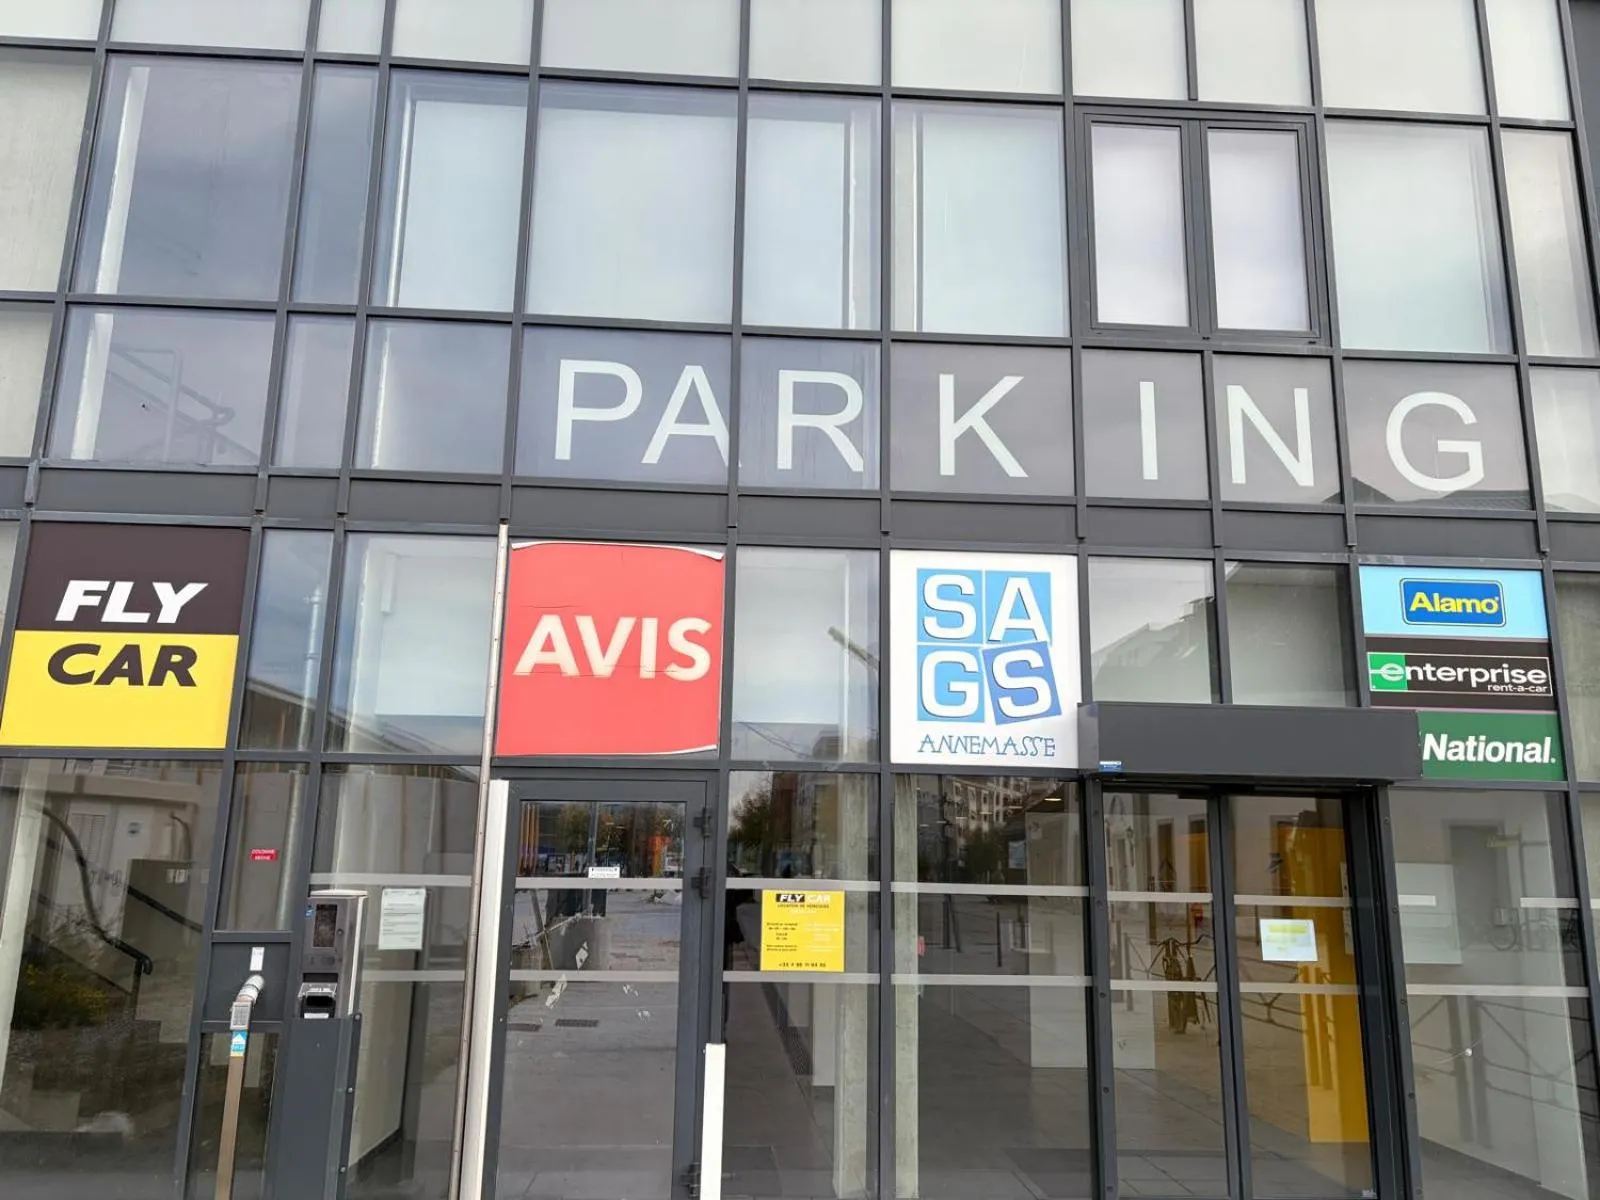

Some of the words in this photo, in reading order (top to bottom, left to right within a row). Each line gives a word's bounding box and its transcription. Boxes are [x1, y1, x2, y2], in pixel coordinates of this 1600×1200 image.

[554, 358, 1485, 492] PARKING
[55, 579, 209, 624] FLY
[1410, 591, 1500, 615] Alamo
[512, 613, 713, 682] AVIS
[47, 642, 198, 688] CAR
[1379, 661, 1547, 688] enterprise
[1487, 683, 1548, 694] rent-a-car
[917, 733, 1056, 757] ANNEMASSE
[779, 893, 804, 903] FLY
[806, 893, 831, 904] CAR
